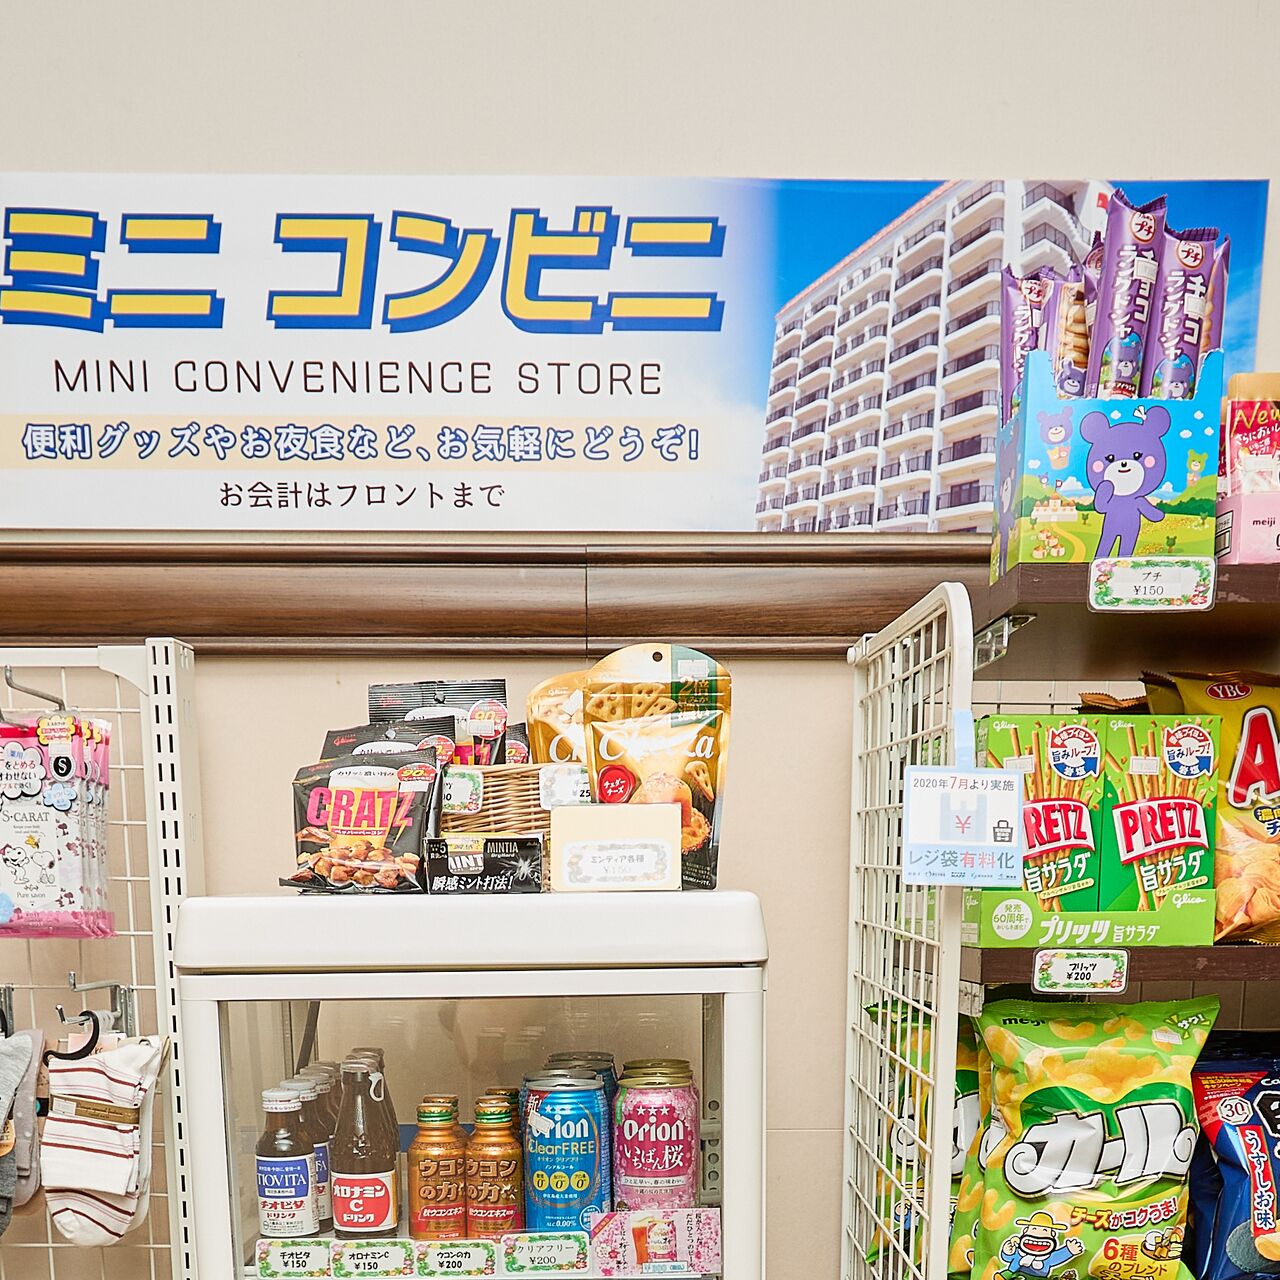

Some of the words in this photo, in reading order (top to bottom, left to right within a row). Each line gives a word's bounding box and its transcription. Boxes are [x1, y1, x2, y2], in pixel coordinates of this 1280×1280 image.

[267, 206, 727, 334] コンビニ
[54, 360, 150, 395] MINI
[173, 360, 492, 395] CONVENIENCE
[518, 362, 663, 396] STORE
[22, 422, 702, 462] 便利グッズやお夜食など、お気軽にどうぞ!
[220, 481, 505, 511] お会計はフロントまで
[1133, 585, 1164, 595] ¥150
[1213, 684, 1246, 697] YBC
[914, 776, 1014, 791] 2020年7月より実施
[307, 787, 413, 827] CRATZ
[1120, 802, 1201, 853] PRETZ
[487, 842, 518, 853] MINTIA
[591, 855, 644, 863] ミンティア各種
[910, 850, 1014, 869] レジ袋有料化
[1172, 894, 1207, 908] Glico
[1039, 915, 1111, 945] プリッツ
[1113, 925, 1160, 942] 旨サラダ
[1069, 963, 1097, 971] プリッツ
[1067, 972, 1091, 980] ¥200
[623, 1115, 684, 1141] Orion
[1005, 1103, 1197, 1195] カール
[1245, 1130, 1274, 1229] うすしお味
[333, 1185, 385, 1198] オロナミン
[261, 1201, 304, 1209] チオビタ
[349, 1200, 363, 1212] C
[343, 1214, 375, 1223] ドリンク
[1070, 1197, 1177, 1228] チーズがコクうま!
[279, 1251, 311, 1260] チオビタ
[436, 1250, 471, 1261] ウコンの力
[518, 1243, 574, 1255] クリアフリー
[348, 1251, 389, 1261] オロナミンC
[529, 1255, 557, 1265] ¥200
[283, 1260, 307, 1268] ¥150
[354, 1261, 378, 1270] ¥150
[438, 1260, 462, 1269] ¥200
[1108, 1261, 1167, 1275] のブレンド
